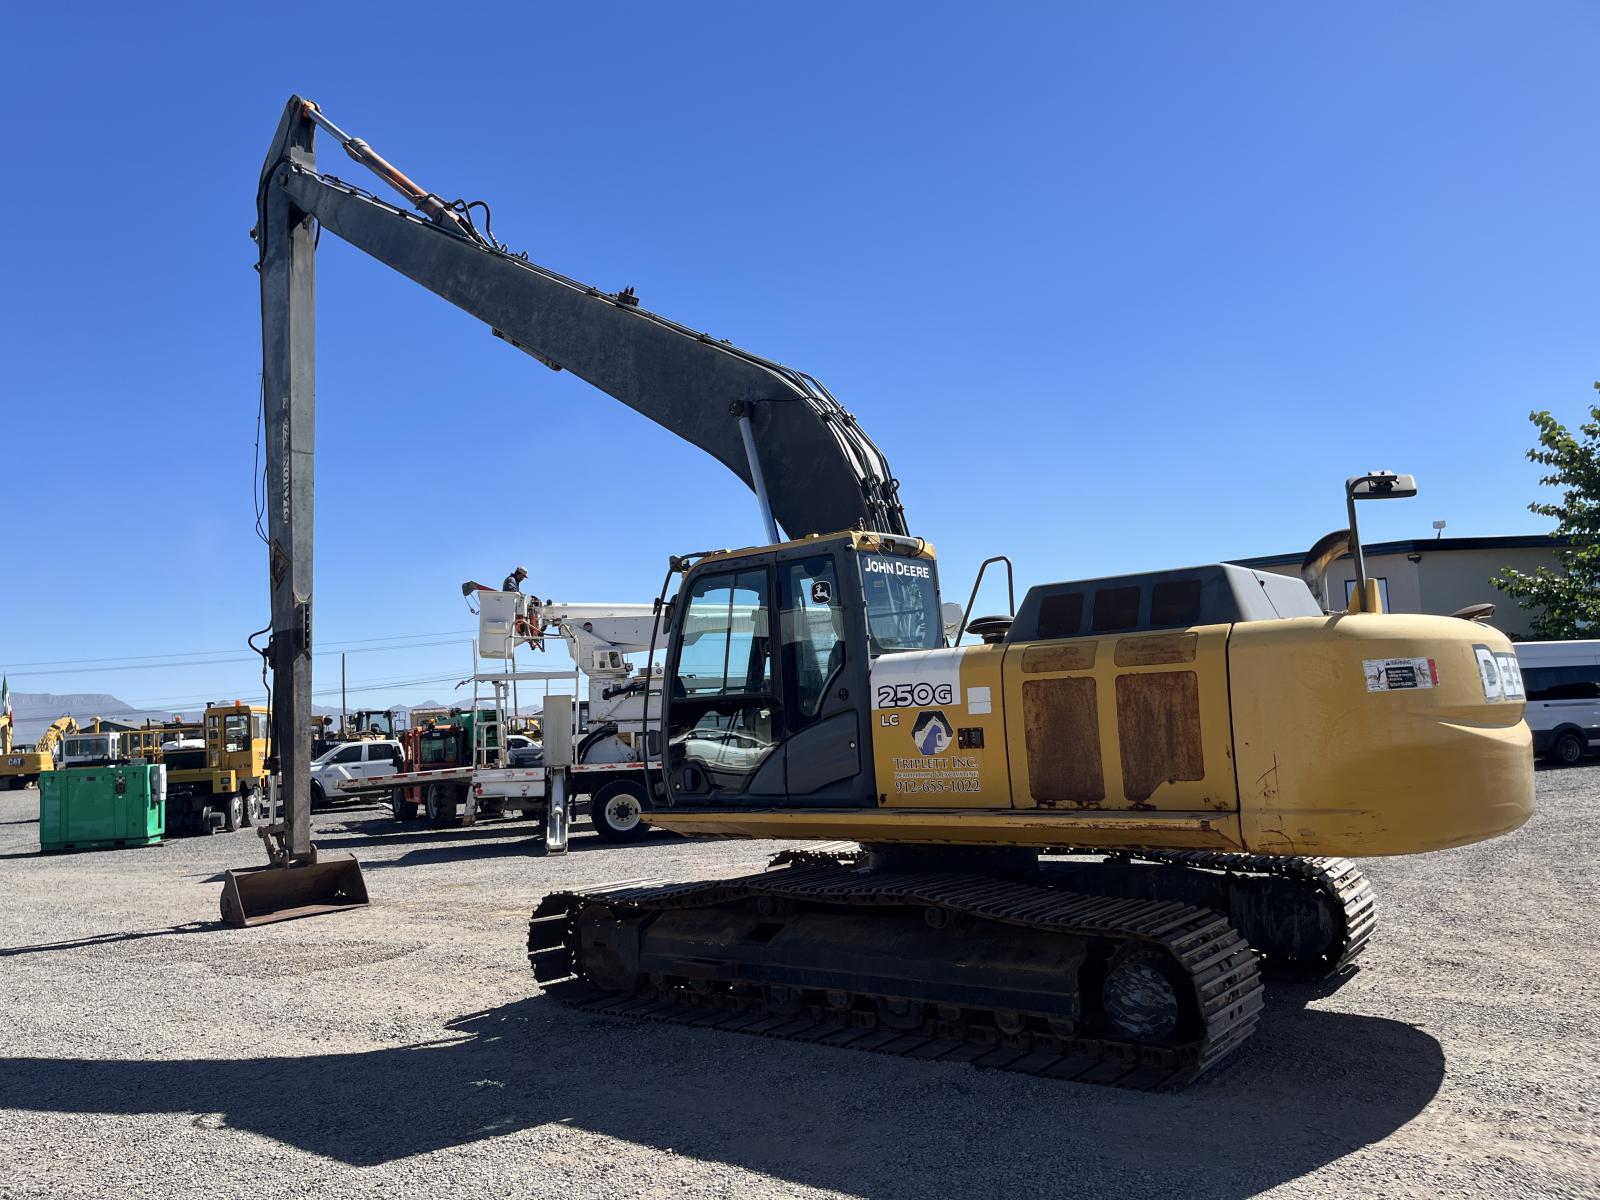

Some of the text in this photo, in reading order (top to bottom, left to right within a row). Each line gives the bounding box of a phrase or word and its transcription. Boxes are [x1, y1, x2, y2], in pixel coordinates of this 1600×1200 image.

[865, 558, 929, 578] JOHN DEERE
[878, 683, 952, 708] 250G
[881, 714, 899, 726] LC
[8, 757, 22, 766] CAT
[895, 756, 978, 769] TRIPLETT INC.
[895, 779, 981, 793] 912-655-1022
